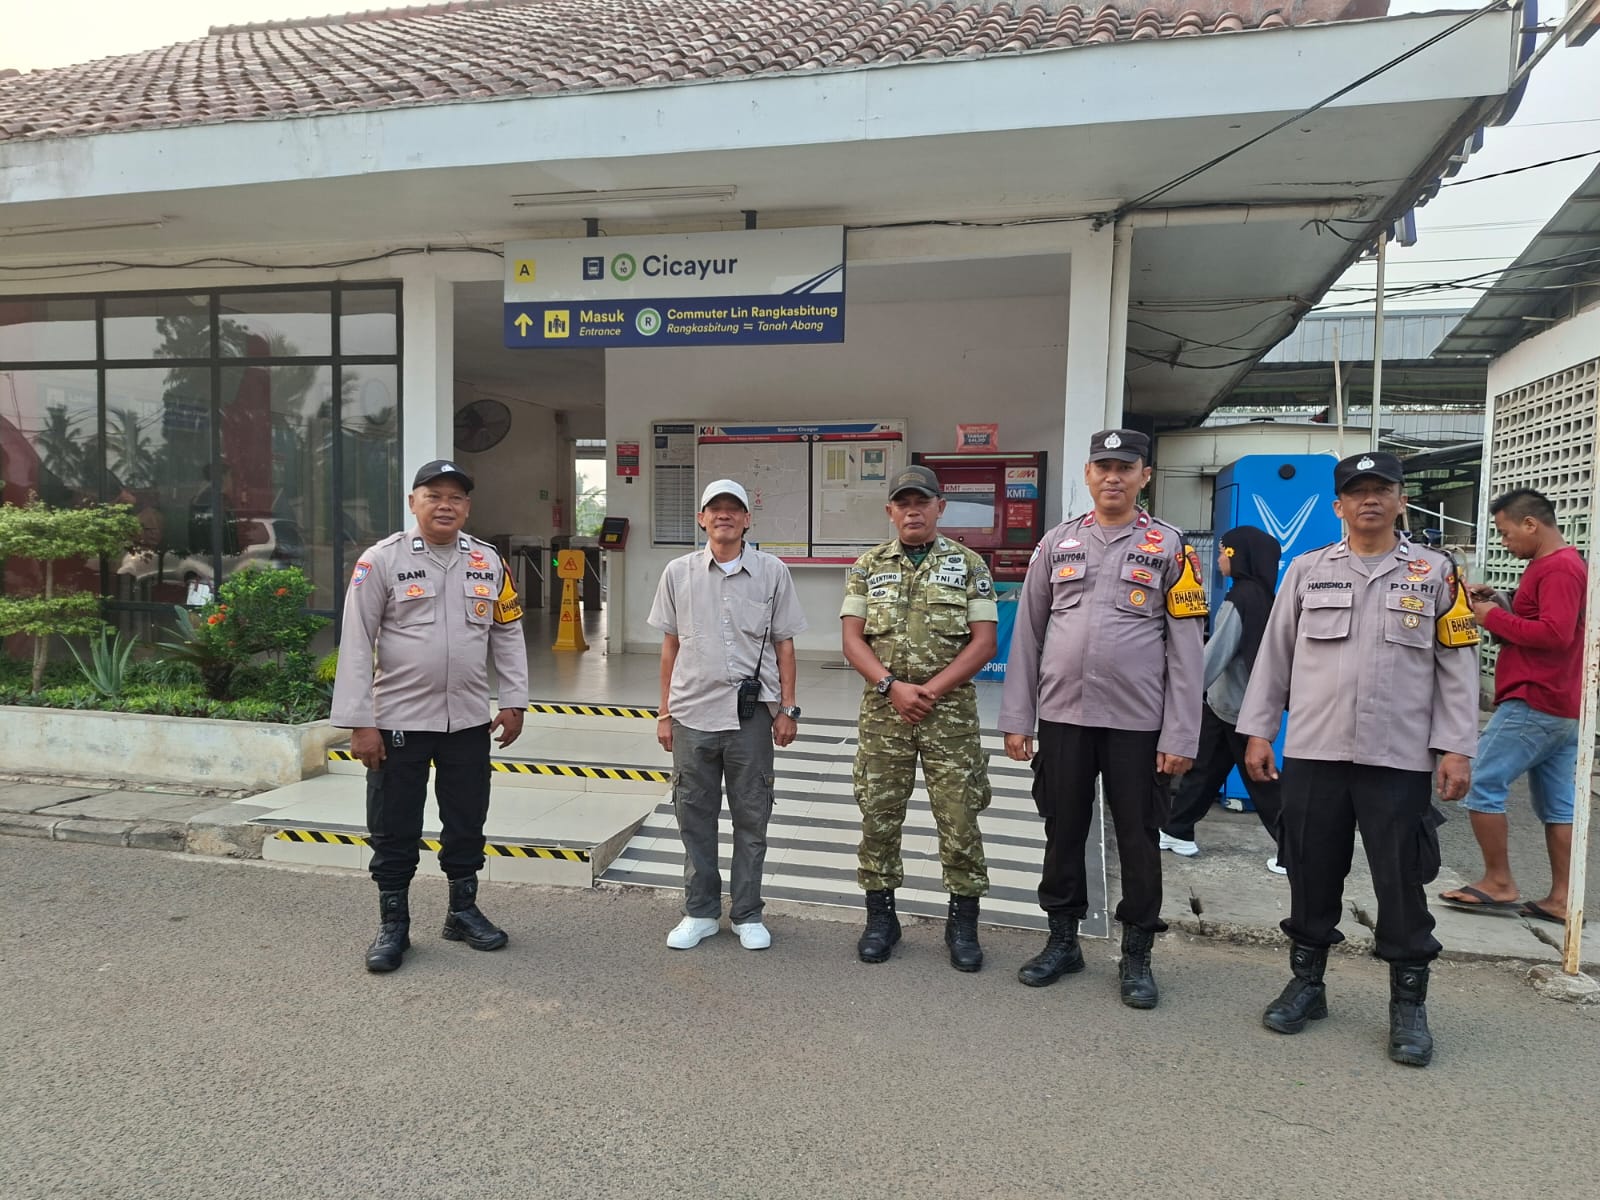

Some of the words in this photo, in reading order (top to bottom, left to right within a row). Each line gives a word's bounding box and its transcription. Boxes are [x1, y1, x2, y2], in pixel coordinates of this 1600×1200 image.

[519, 263, 531, 276] A
[642, 254, 738, 281] Cicayur
[580, 309, 625, 323] Masuk
[667, 308, 729, 320] Commuter
[731, 307, 748, 319] Lin
[751, 305, 838, 319] Rangkasbitung
[645, 316, 652, 327] R
[667, 322, 740, 334] Rangkasbitung
[758, 321, 788, 331] Tanah
[790, 320, 824, 332] Abang
[579, 326, 622, 336] Entrance
[1006, 489, 1026, 498] KMT
[1127, 553, 1164, 568] POLRI
[397, 570, 426, 581] BANI
[466, 571, 494, 581] POLRI
[954, 577, 965, 586] AL
[1390, 583, 1434, 594] POLRI
[982, 662, 1008, 673] SPORT
